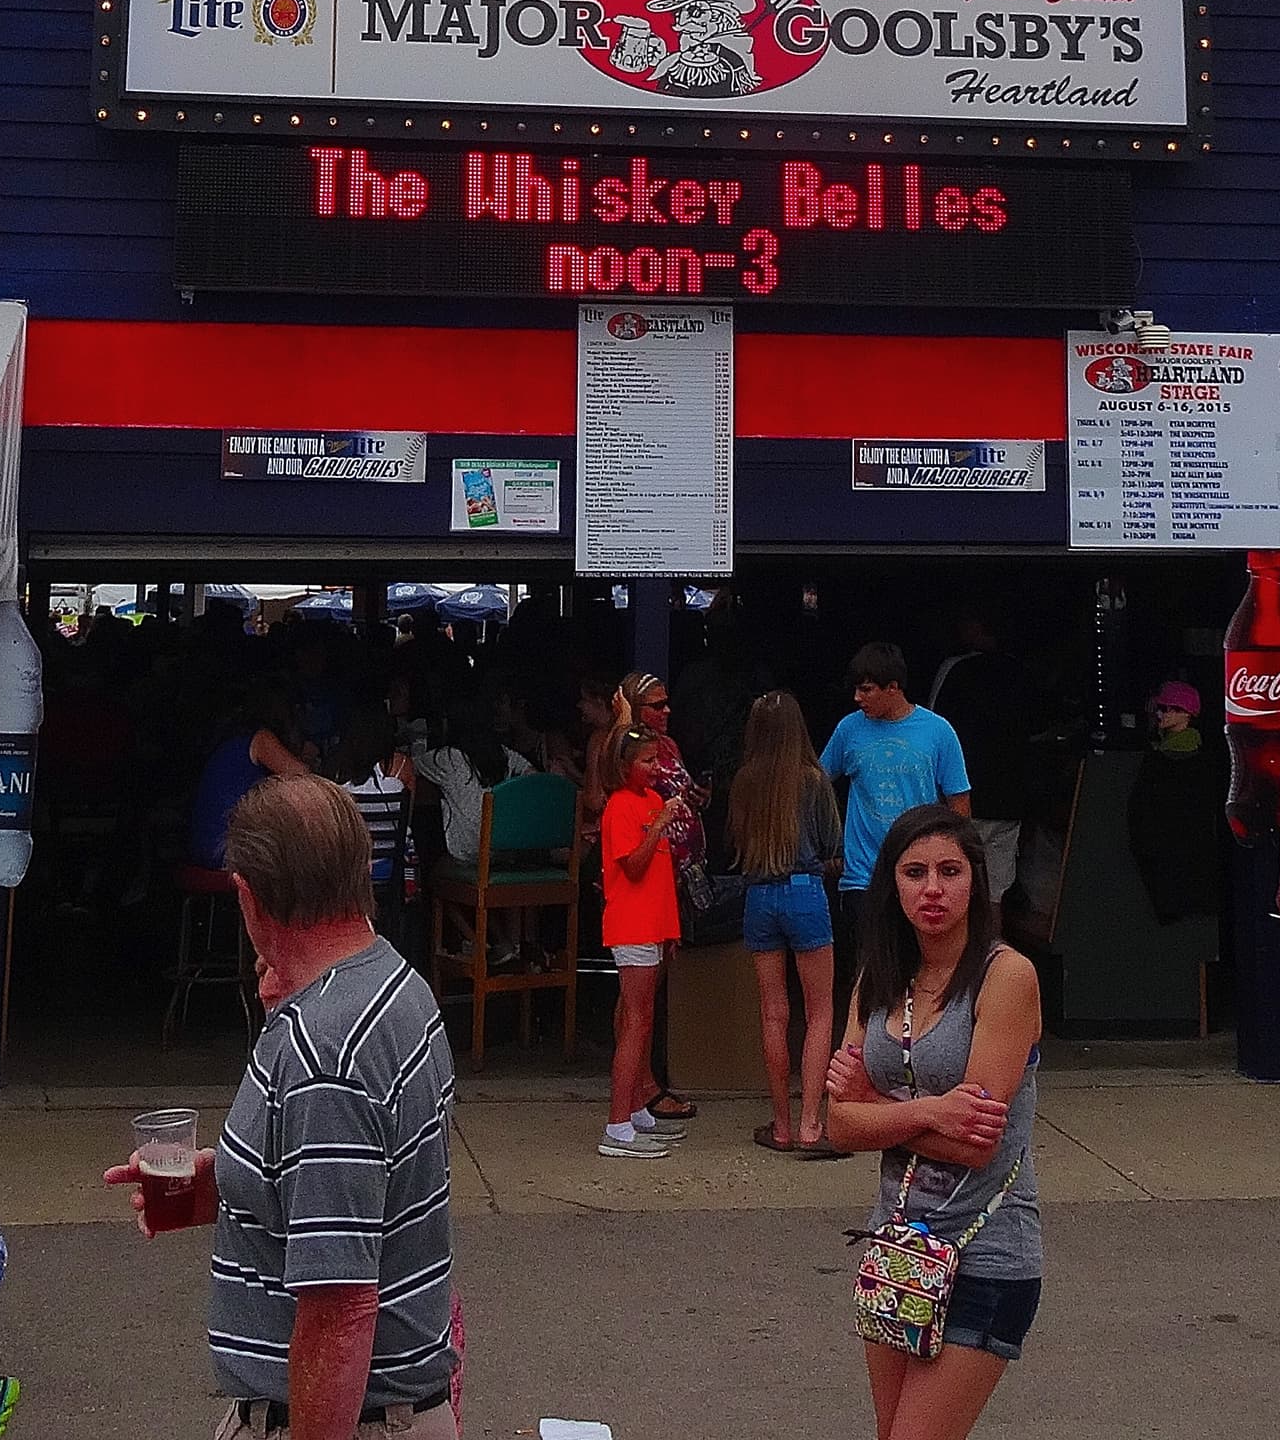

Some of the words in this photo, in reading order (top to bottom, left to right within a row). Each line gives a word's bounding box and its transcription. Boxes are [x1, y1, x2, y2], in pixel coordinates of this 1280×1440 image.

[772, 3, 1144, 63] GOOLSBY'S
[945, 68, 1139, 107] Heartland
[310, 147, 427, 219] The
[464, 152, 740, 224] Whiskey
[782, 160, 1009, 232] Belles
[546, 227, 778, 294] noon-3
[1170, 343, 1213, 356] STATE
[1219, 345, 1253, 361] FAIR
[1136, 364, 1245, 384] HEARTLAND
[1160, 385, 1220, 401] STAGE
[1098, 400, 1153, 412] AUGUST
[1157, 401, 1193, 413] 6-16,
[1197, 402, 1231, 413] 2015
[229, 436, 255, 454] ENJOY
[257, 437, 272, 454] THE
[273, 437, 296, 455] GAME
[297, 438, 318, 455] WITH
[319, 438, 325, 455] A
[859, 447, 885, 465] ENJOY
[886, 447, 900, 465] THE
[901, 448, 922, 465] GAME
[923, 448, 943, 465] WITH
[267, 457, 284, 475] AND
[285, 458, 303, 475] OUR
[304, 457, 360, 478] GARLIC
[357, 459, 404, 479] FRIES
[886, 467, 903, 485] AND
[911, 467, 970, 486] MAJOR
[968, 468, 1029, 486] BURGER
